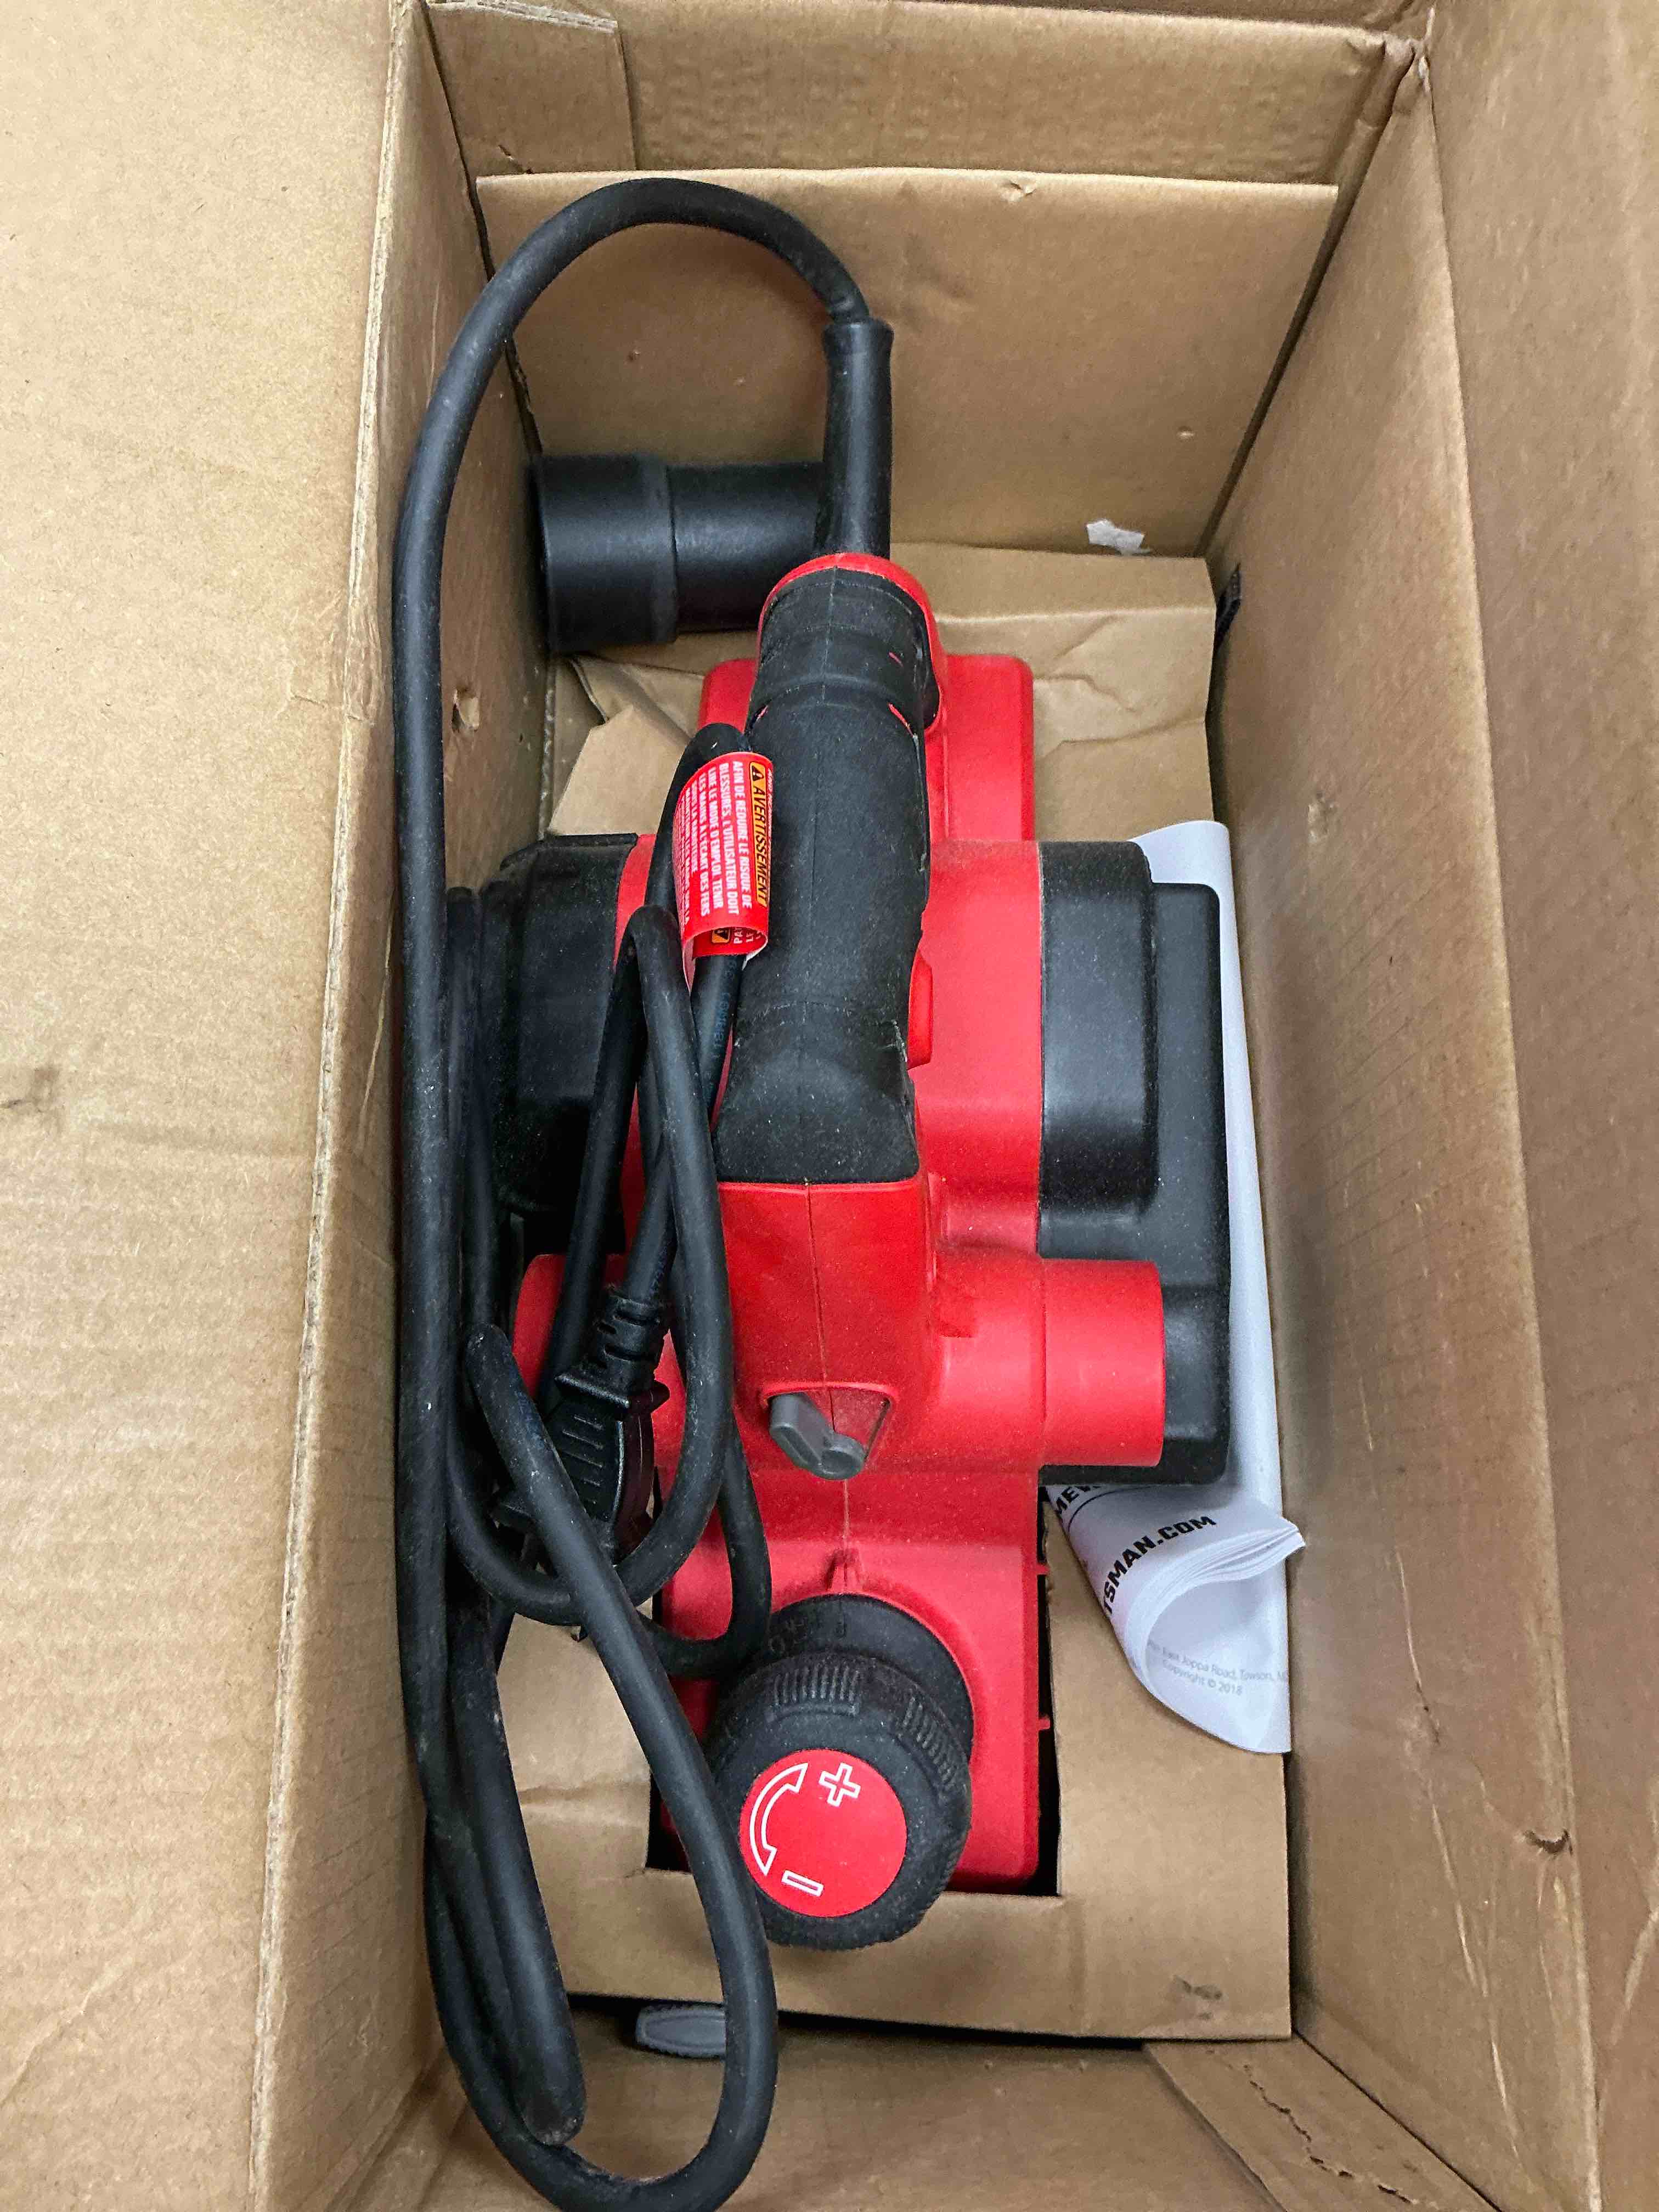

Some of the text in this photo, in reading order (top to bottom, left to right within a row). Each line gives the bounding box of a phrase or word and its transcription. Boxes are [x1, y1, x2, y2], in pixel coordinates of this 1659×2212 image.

[698, 773, 707, 792] LES
[708, 767, 718, 789] LIRE
[732, 761, 745, 783] AFIN
[708, 788, 718, 802] LE
[734, 785, 746, 798] DE
[699, 791, 707, 825] MAINS
[709, 800, 719, 830] MODE
[738, 842, 749, 854] LE
[754, 786, 768, 902] AVERTISSEMENT
[699, 871, 709, 893] DES
[740, 856, 752, 893] RISQUE
[700, 891, 710, 917] FERS
[712, 878, 724, 909] TENIR
[727, 891, 740, 915] DOIT
[742, 894, 753, 909] DE
